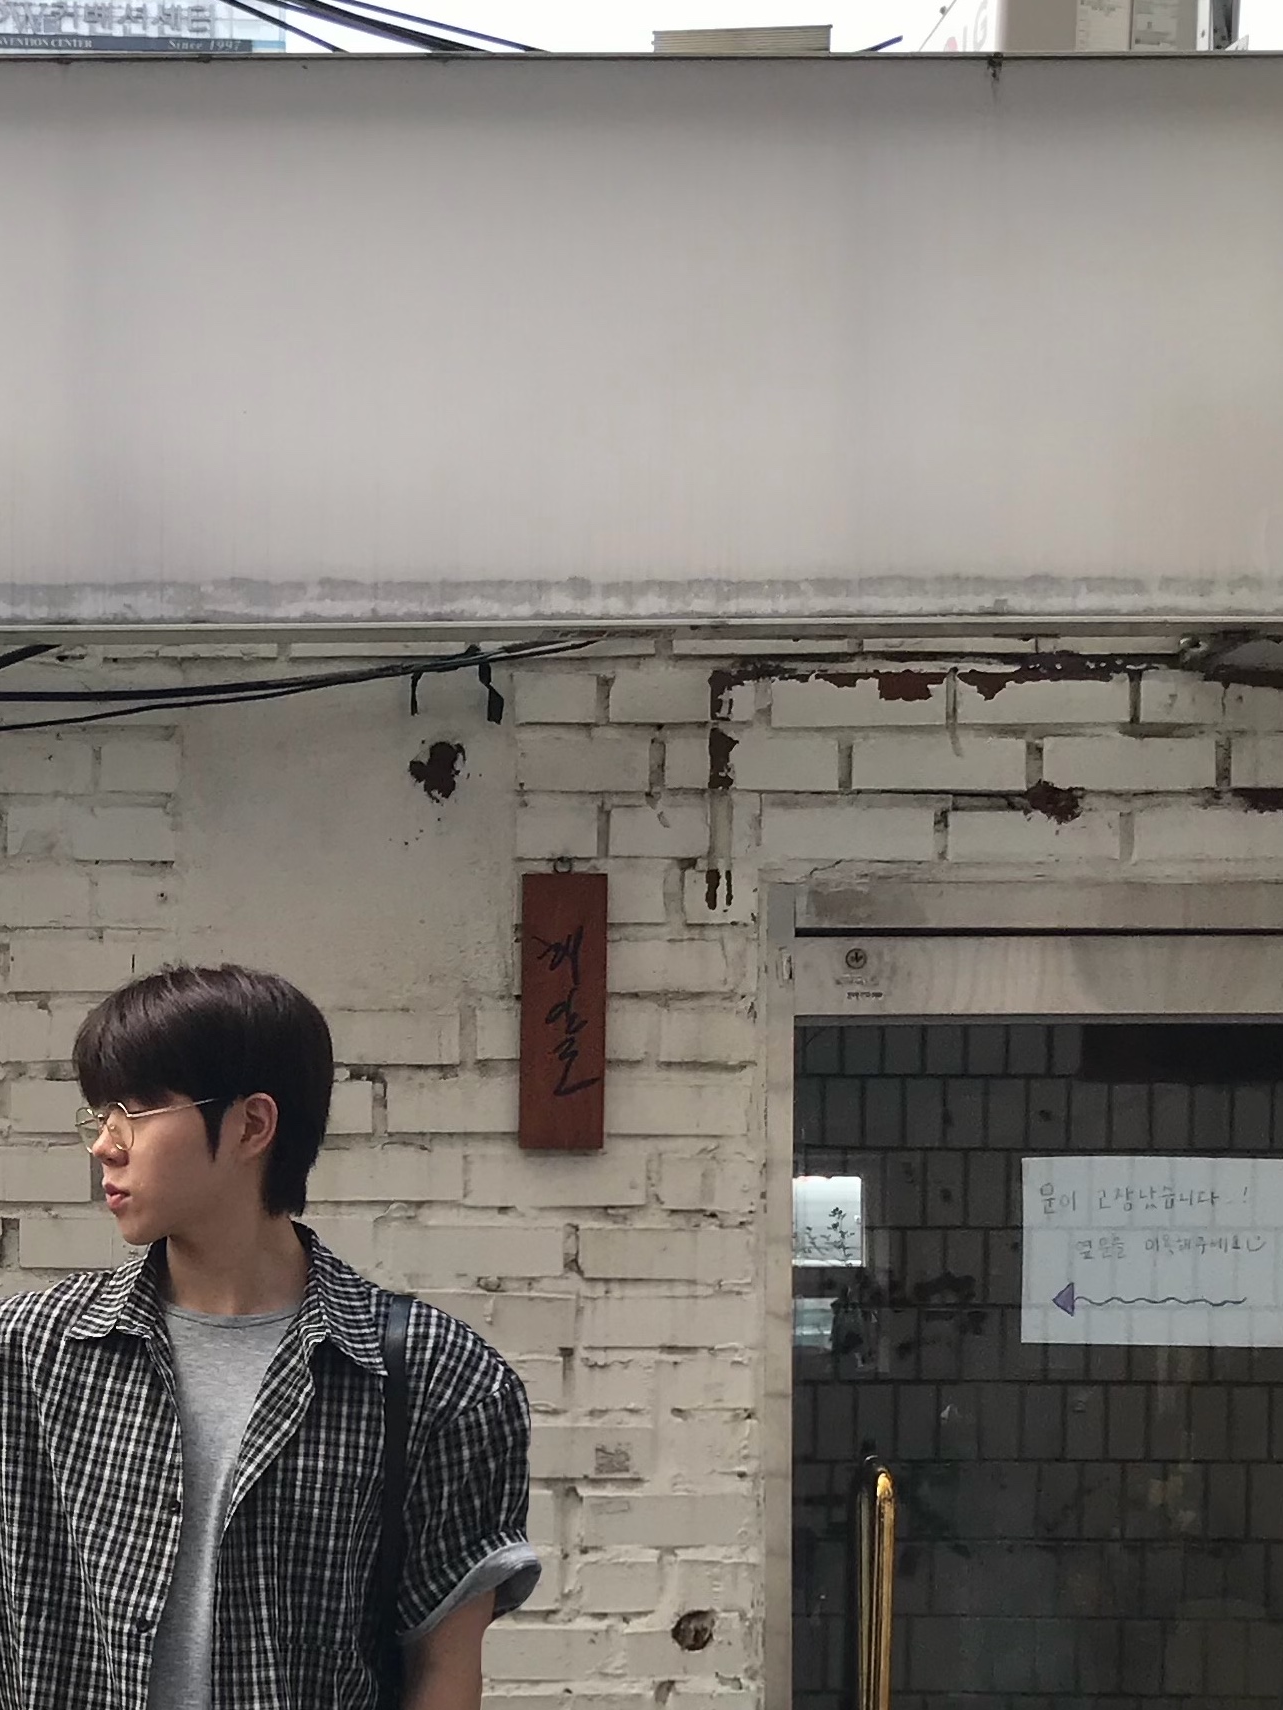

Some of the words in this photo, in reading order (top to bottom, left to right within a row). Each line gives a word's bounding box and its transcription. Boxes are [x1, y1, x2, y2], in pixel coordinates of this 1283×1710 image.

[51, 38, 92, 48] CENTER
[168, 40, 203, 50] Since
[209, 40, 241, 50] 1997
[1039, 1182, 1075, 1214] 문이
